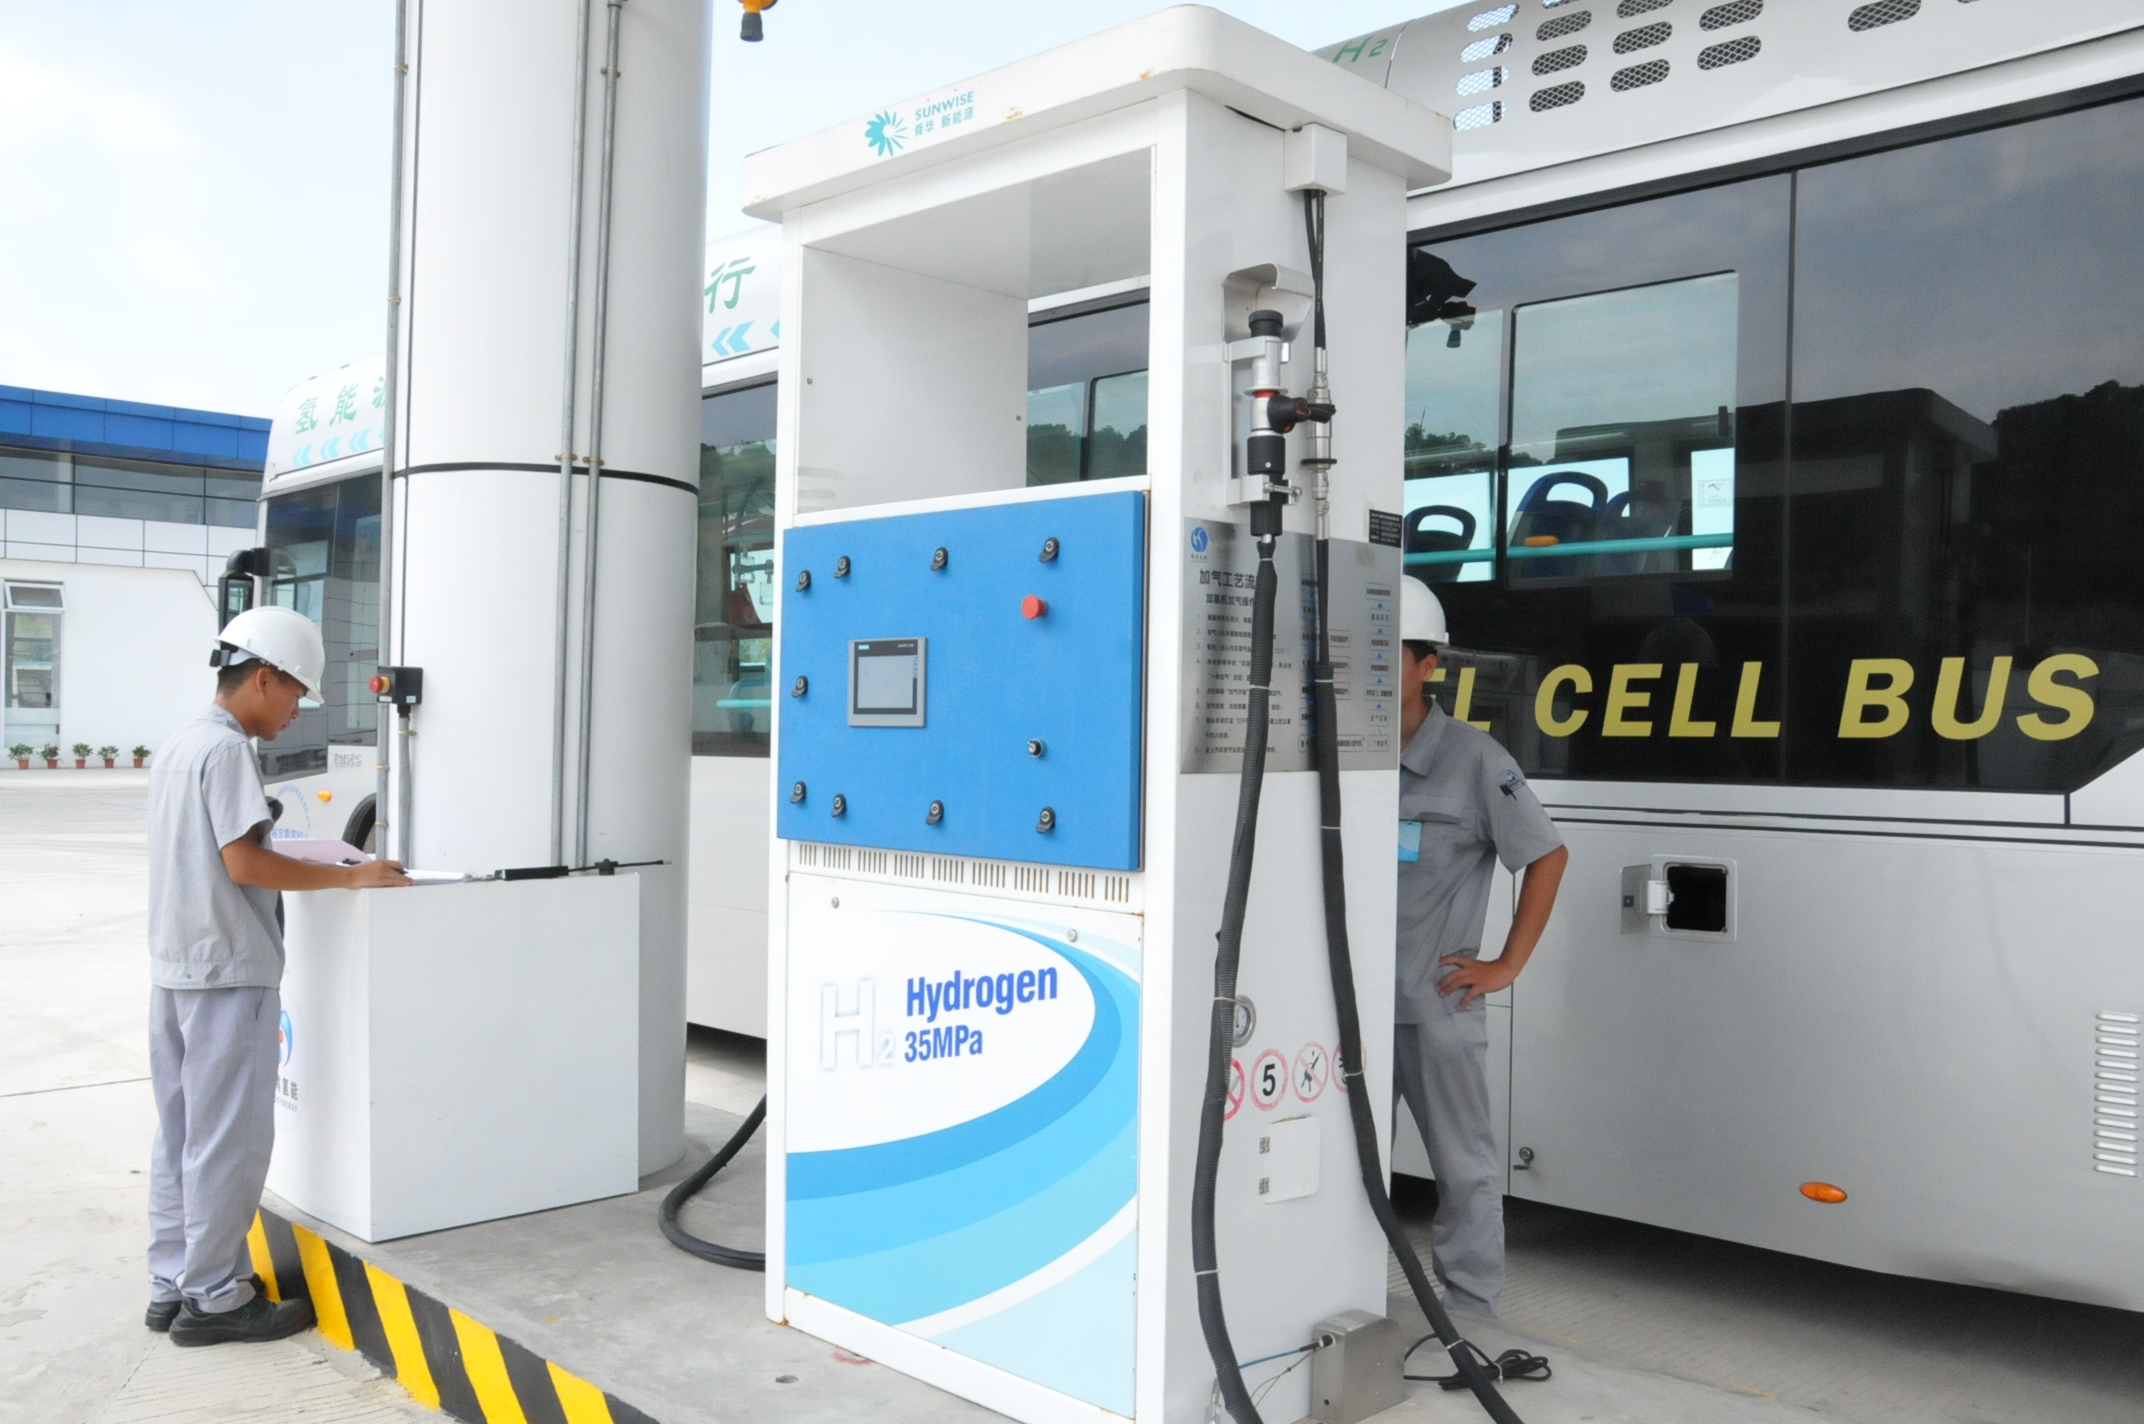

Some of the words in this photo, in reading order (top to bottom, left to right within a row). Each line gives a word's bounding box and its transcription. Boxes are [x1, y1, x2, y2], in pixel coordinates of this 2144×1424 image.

[1332, 35, 1388, 63] H2
[915, 90, 975, 121] SUNWISE
[941, 106, 974, 128] 新能源
[703, 256, 757, 314] 行
[1534, 661, 1781, 738] CELL
[1837, 653, 2100, 741] BUS
[820, 976, 896, 1072] H2
[906, 966, 1058, 1023] Hydrogen
[904, 1024, 983, 1063] 35MPa
[1262, 1063, 1276, 1096] 5
